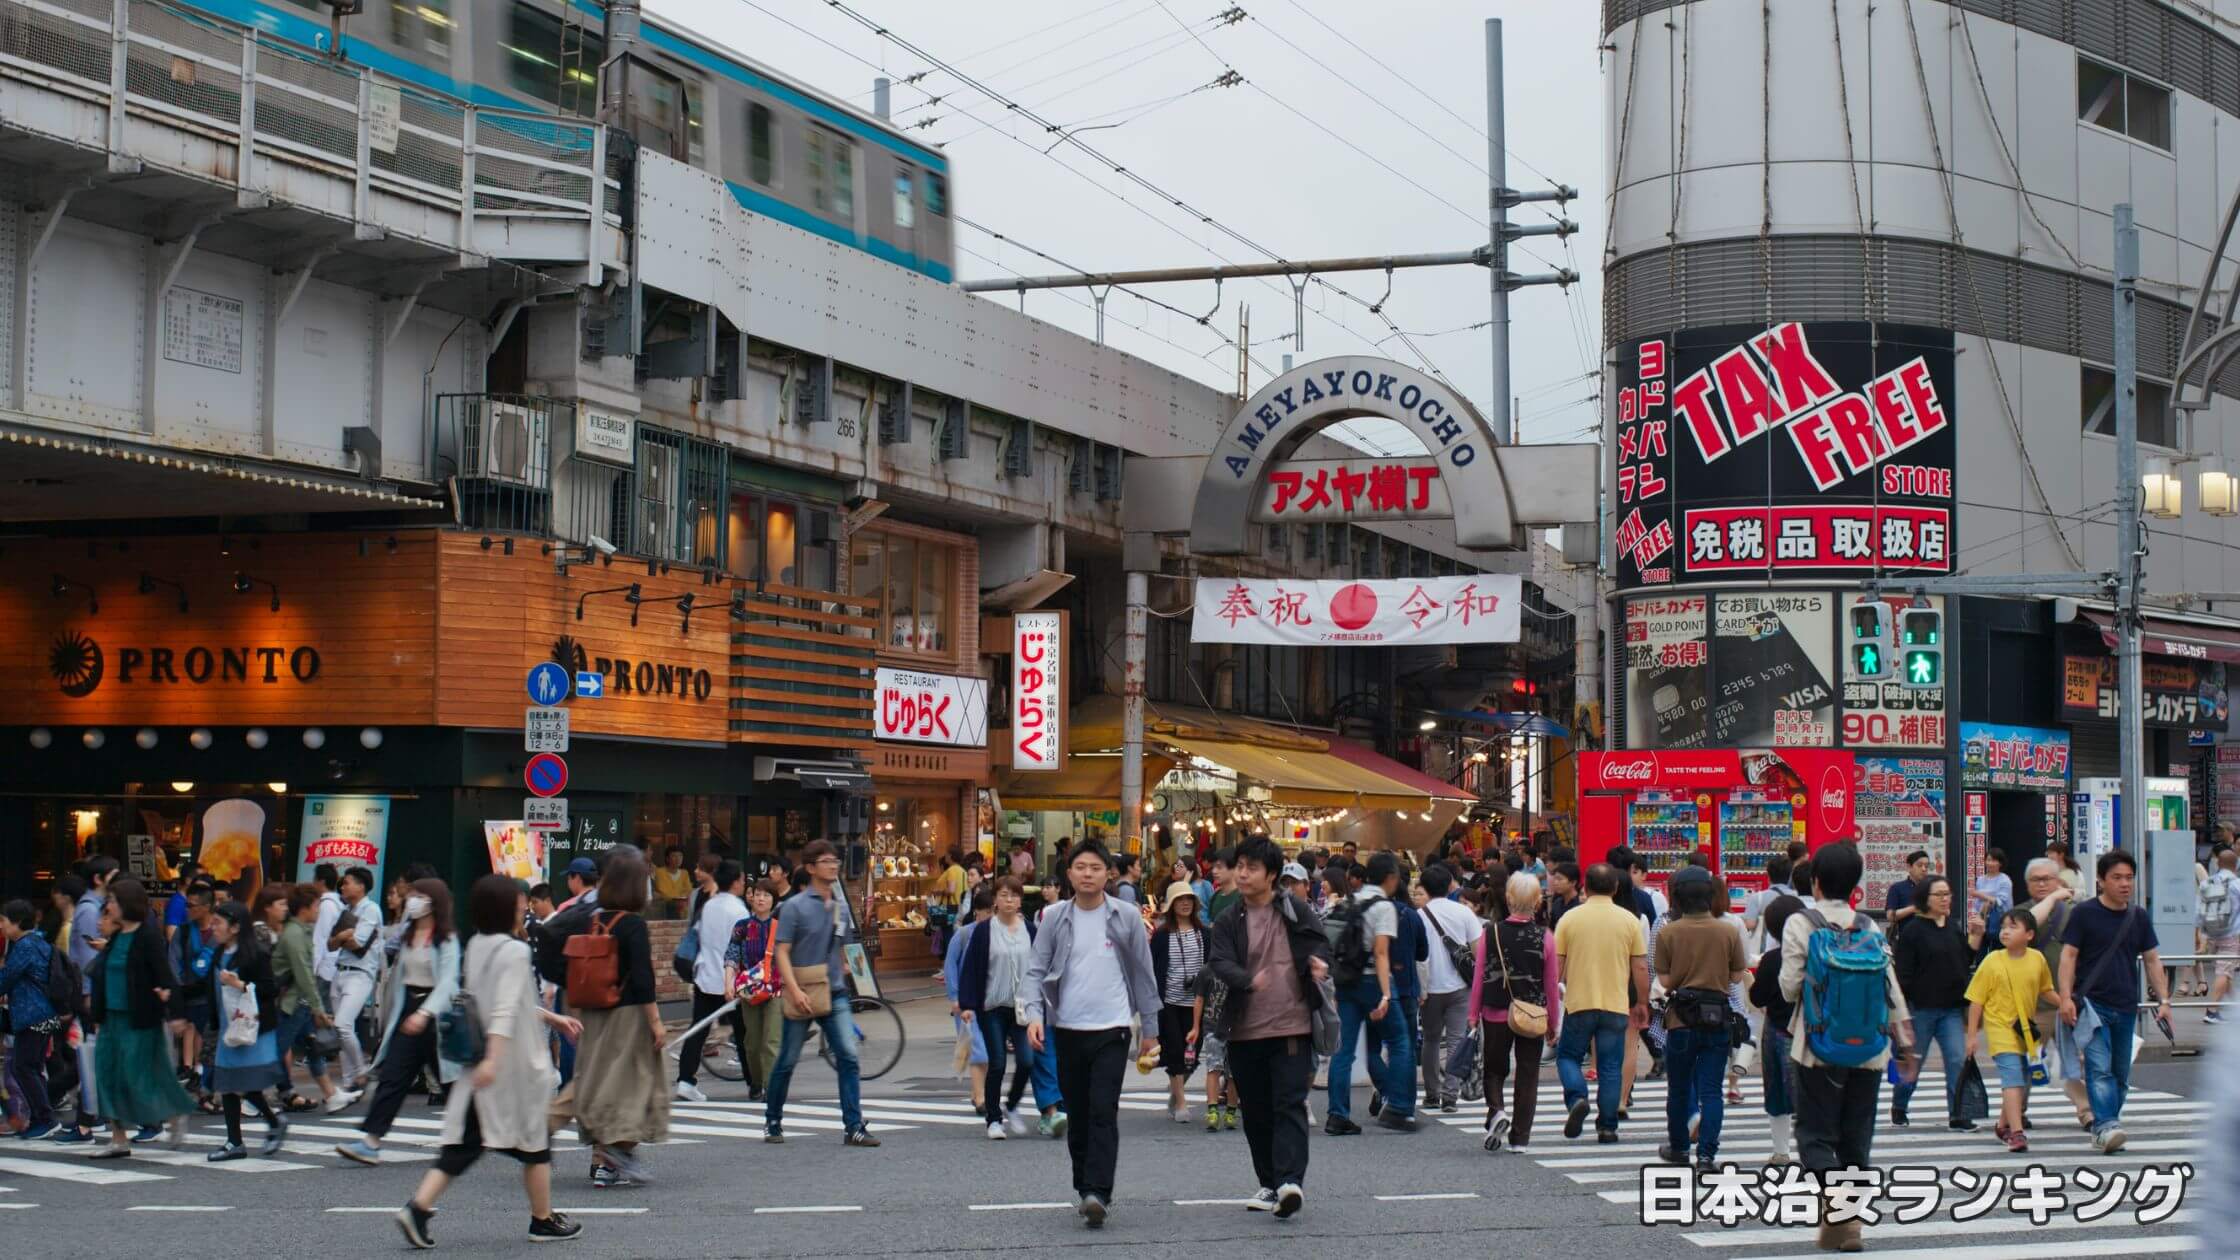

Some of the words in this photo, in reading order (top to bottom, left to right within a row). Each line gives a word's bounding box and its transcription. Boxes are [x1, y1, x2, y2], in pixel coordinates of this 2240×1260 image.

[1224, 369, 1475, 478] AMEYAYOKOCHO
[1639, 340, 1666, 500] ヨドバシ
[1674, 322, 1842, 463] TAX
[1785, 356, 1947, 491] FREE
[837, 418, 855, 438] 266
[1618, 387, 1637, 503] カメラ
[1269, 465, 1439, 513] アメヤ横丁
[1884, 465, 1951, 497] STORE
[1617, 507, 1646, 560] TAX
[1634, 519, 1673, 572] FREE
[1692, 519, 1945, 561] 免税品取扱店
[1642, 569, 1670, 583] STORE
[1215, 584, 1312, 629] 奉祝
[1400, 583, 1500, 630] 令和
[1626, 600, 1705, 617] ヨドバシカメラ
[1718, 598, 1822, 612] でお買い物なら
[1649, 622, 1672, 633] GOLD
[1675, 620, 1704, 631] POINT
[118, 646, 320, 683] PRONTO
[595, 657, 712, 700] PRONTO
[894, 673, 941, 688] RESTAURANT
[1722, 676, 1755, 695] 2345
[1760, 663, 1794, 681] 6789
[883, 689, 951, 738] じゅらく
[1020, 633, 1044, 762] じゅらく
[1780, 684, 1828, 708] VISA
[1603, 760, 1655, 779] Coca-Cola
[1989, 739, 2068, 773] ヨドバシカメラ
